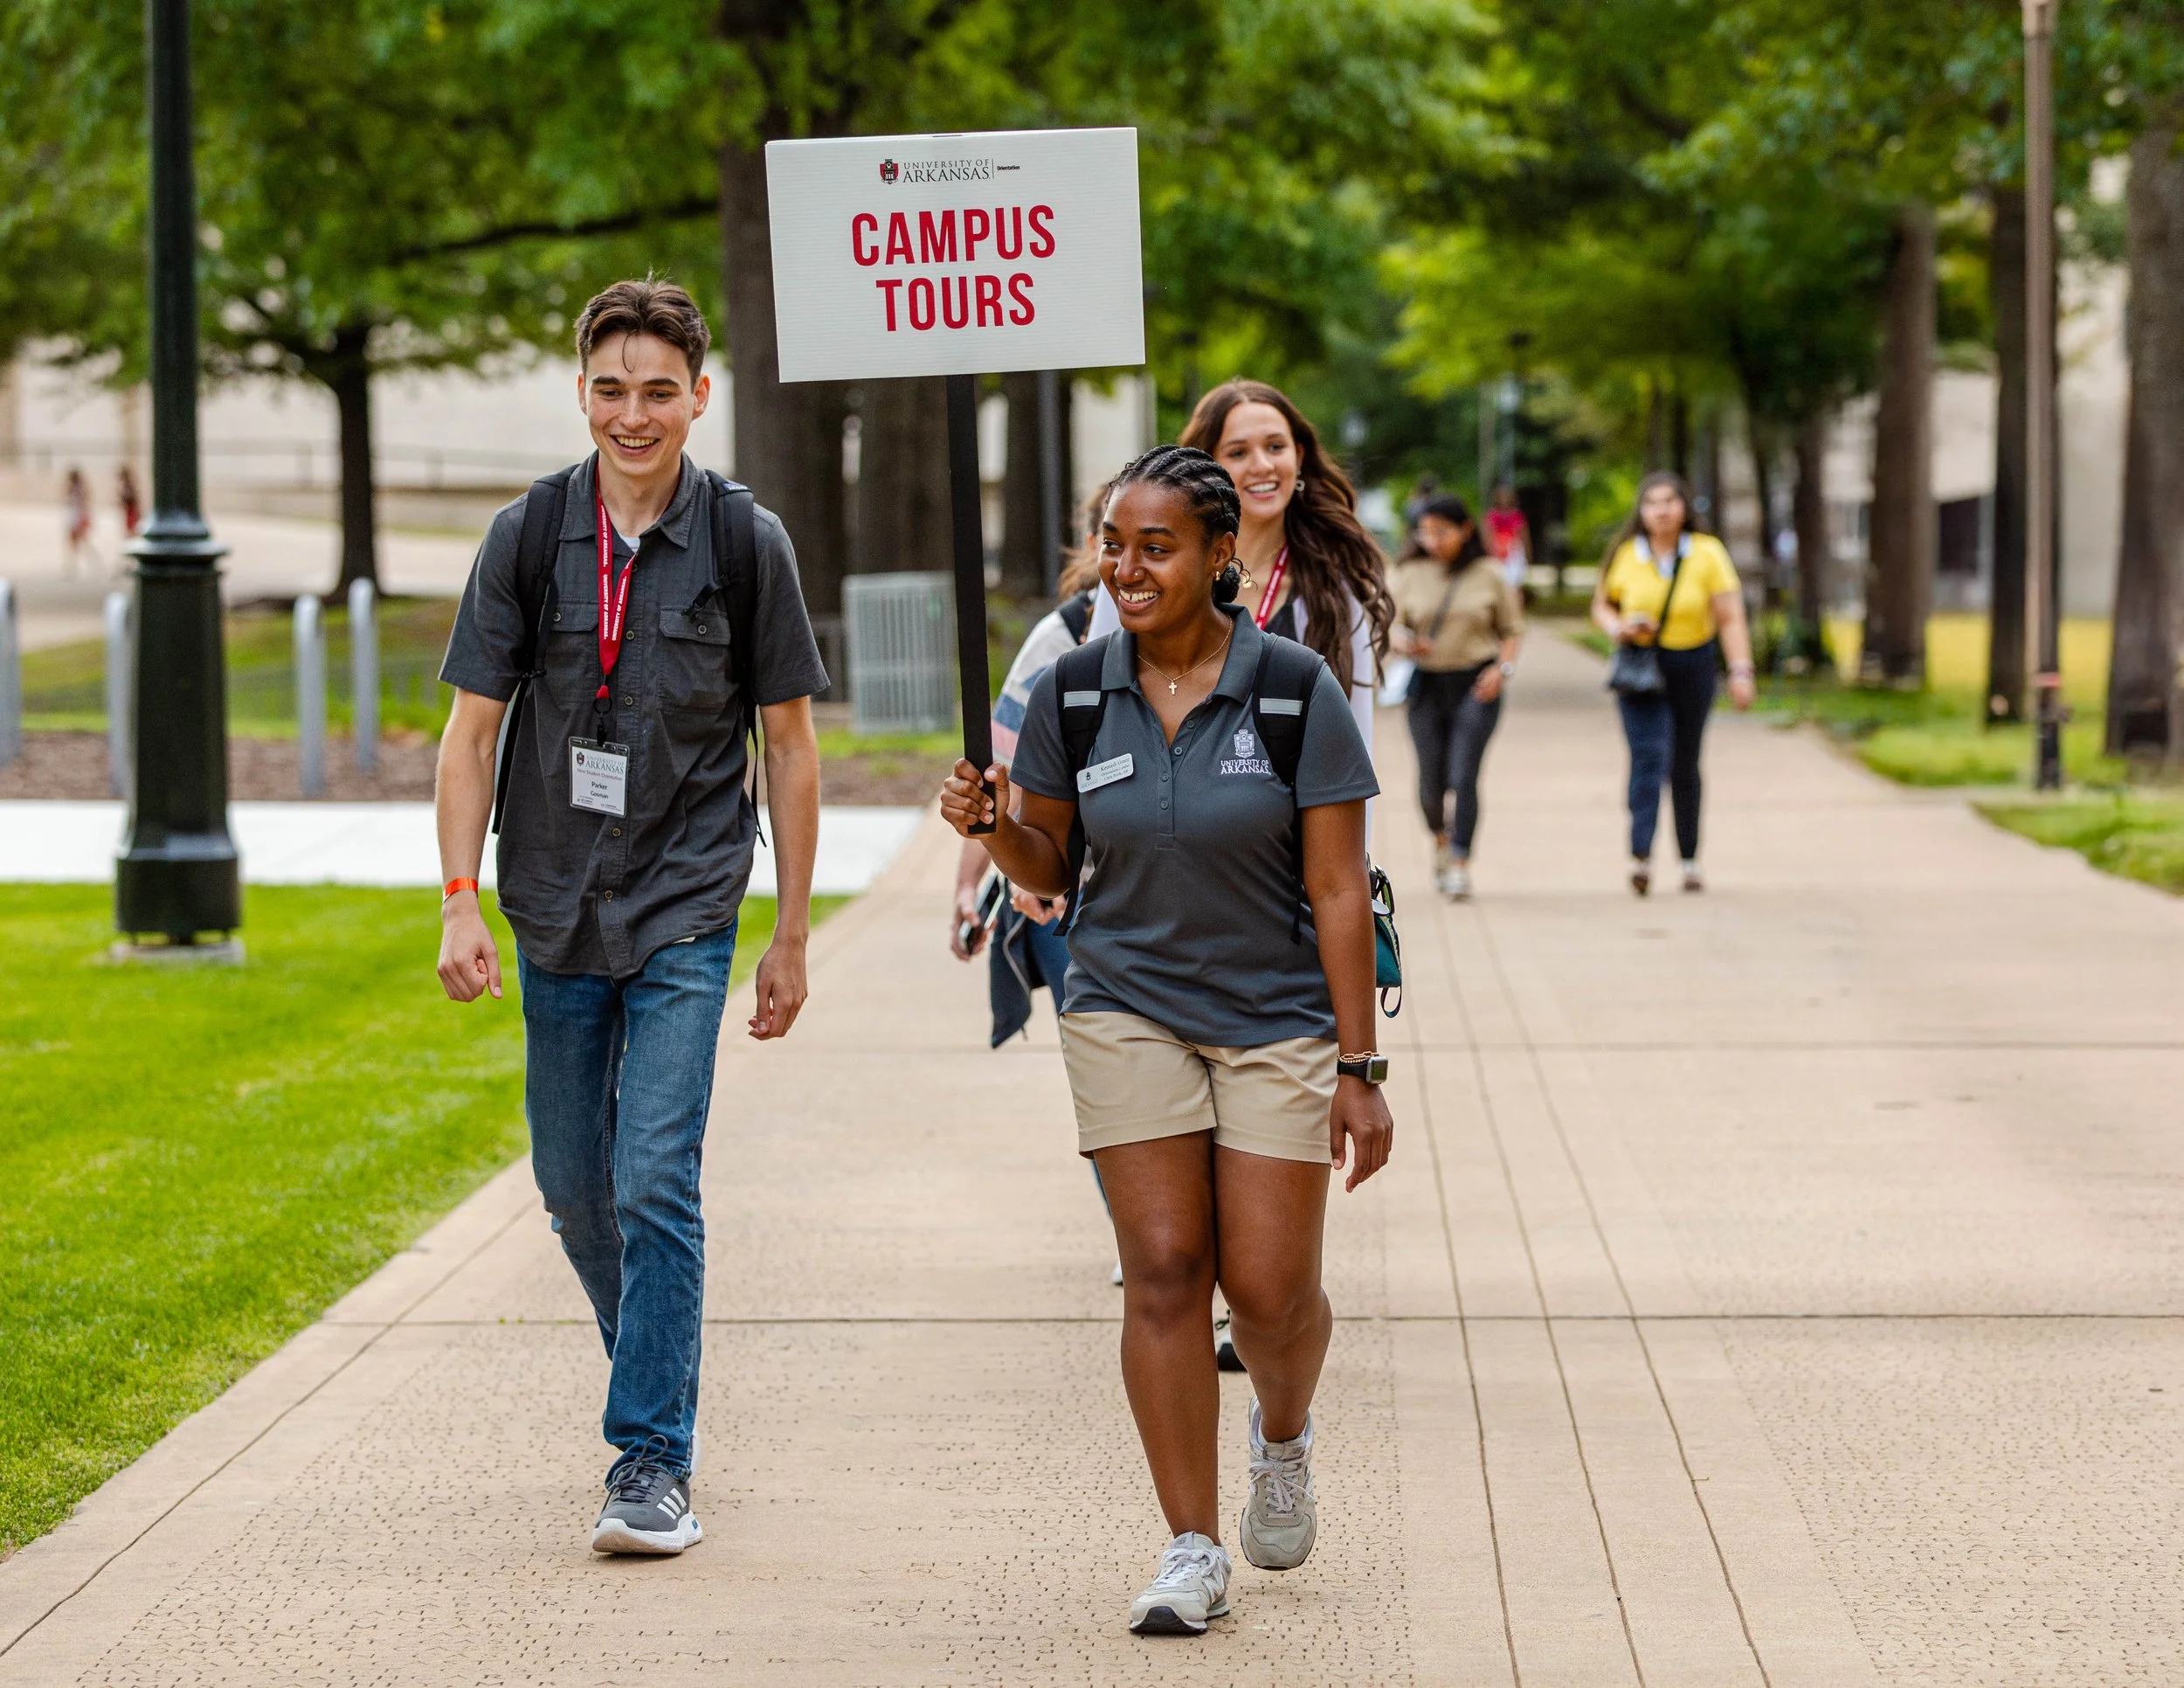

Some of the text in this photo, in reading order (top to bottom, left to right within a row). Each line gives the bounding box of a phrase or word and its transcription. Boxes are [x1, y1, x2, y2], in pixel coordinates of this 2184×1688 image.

[903, 158, 990, 169] UNIVERSITY OF
[852, 204, 1055, 266] CAMPUS
[875, 273, 1035, 332] TOURS
[585, 760, 624, 774] ARKANSAS
[591, 781, 608, 790] Parker
